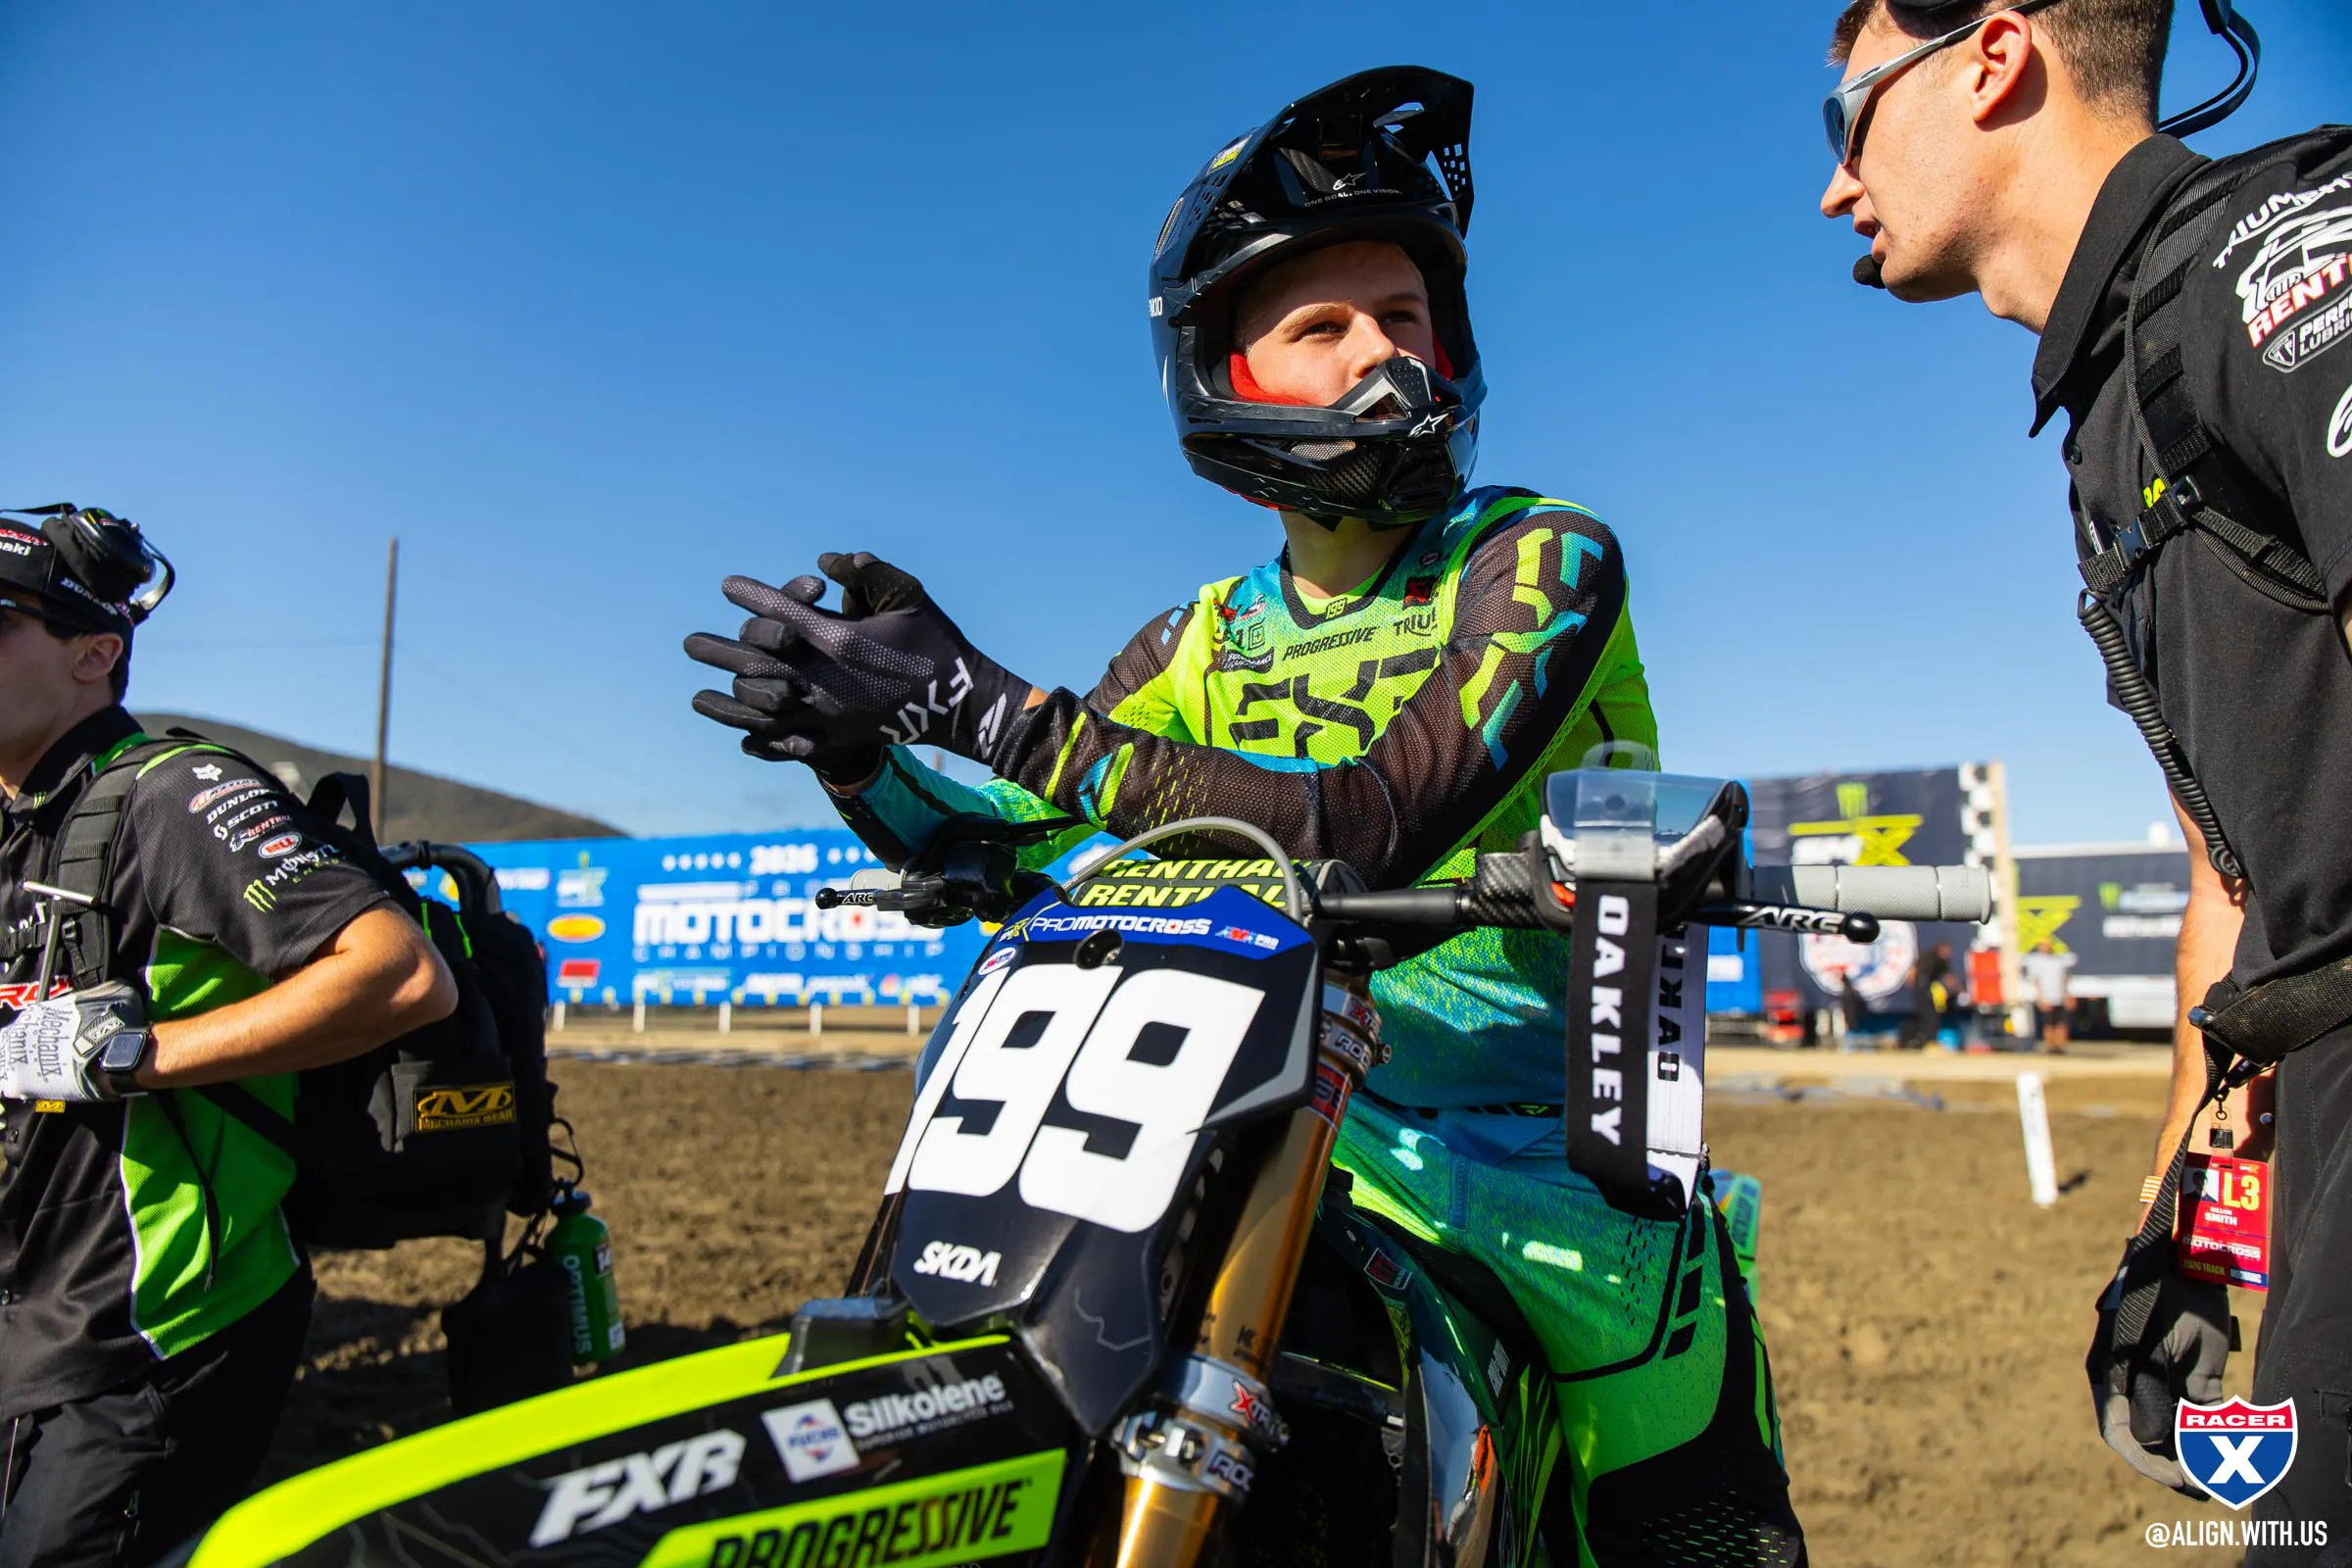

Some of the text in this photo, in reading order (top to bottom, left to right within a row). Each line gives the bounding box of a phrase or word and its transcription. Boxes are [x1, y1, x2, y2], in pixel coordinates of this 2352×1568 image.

[2247, 253, 2352, 349] RENT
[2299, 291, 2352, 344] PERF
[2300, 316, 2352, 357] LUBRI
[1325, 598, 1348, 619] 199
[1393, 608, 1438, 637] TRIU
[1282, 625, 1377, 662] PROGRESSIVE
[1738, 906, 1845, 934] ARC
[1591, 894, 1630, 1147] OAKLEY
[884, 963, 1265, 1233] 199
[2223, 1171, 2260, 1211] L3
[2204, 1212, 2237, 1226] SMITH
[913, 1240, 1002, 1287] SKDA
[844, 1373, 1005, 1439] Silkolene
[529, 1429, 746, 1548] FXR
[706, 1479, 1025, 1568] PROGRESSIVE
